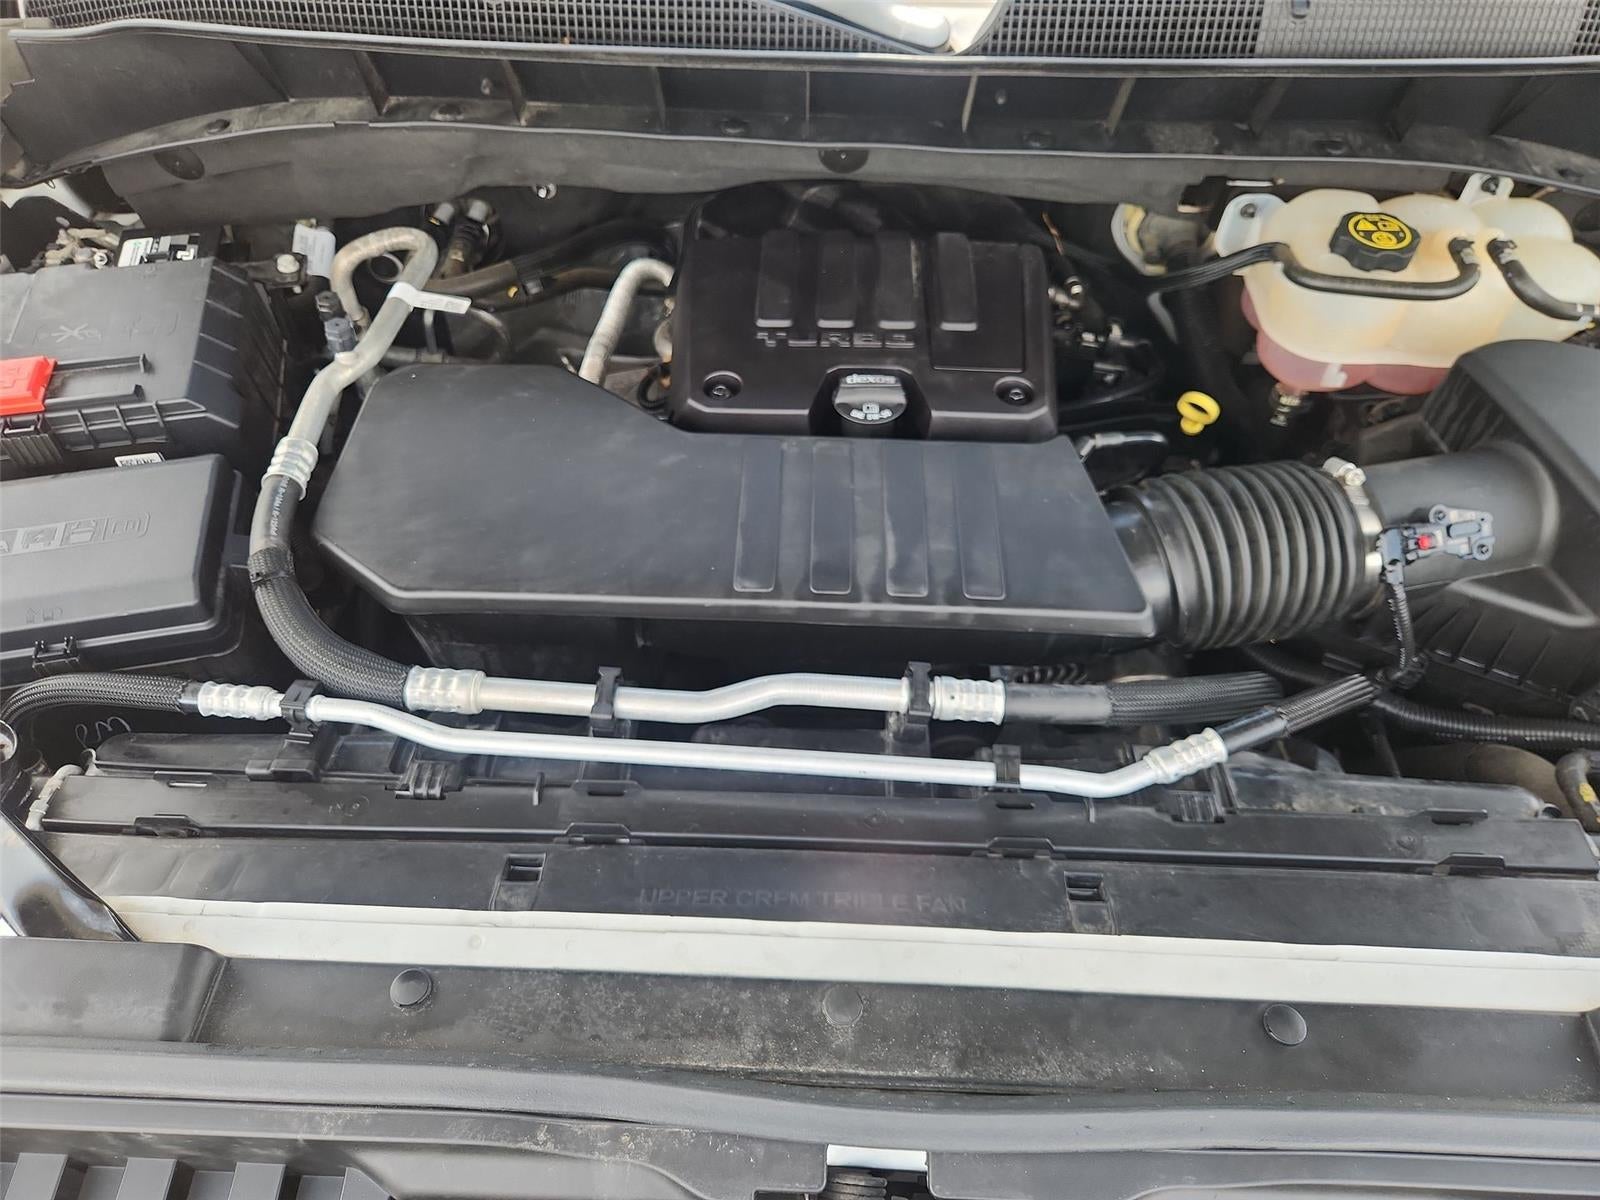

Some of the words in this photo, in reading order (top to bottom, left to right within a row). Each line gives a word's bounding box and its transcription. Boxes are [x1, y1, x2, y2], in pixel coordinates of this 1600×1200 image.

[639, 888, 728, 906] UPPER
[817, 891, 910, 911] TRIPLE
[916, 894, 967, 913] FAN
